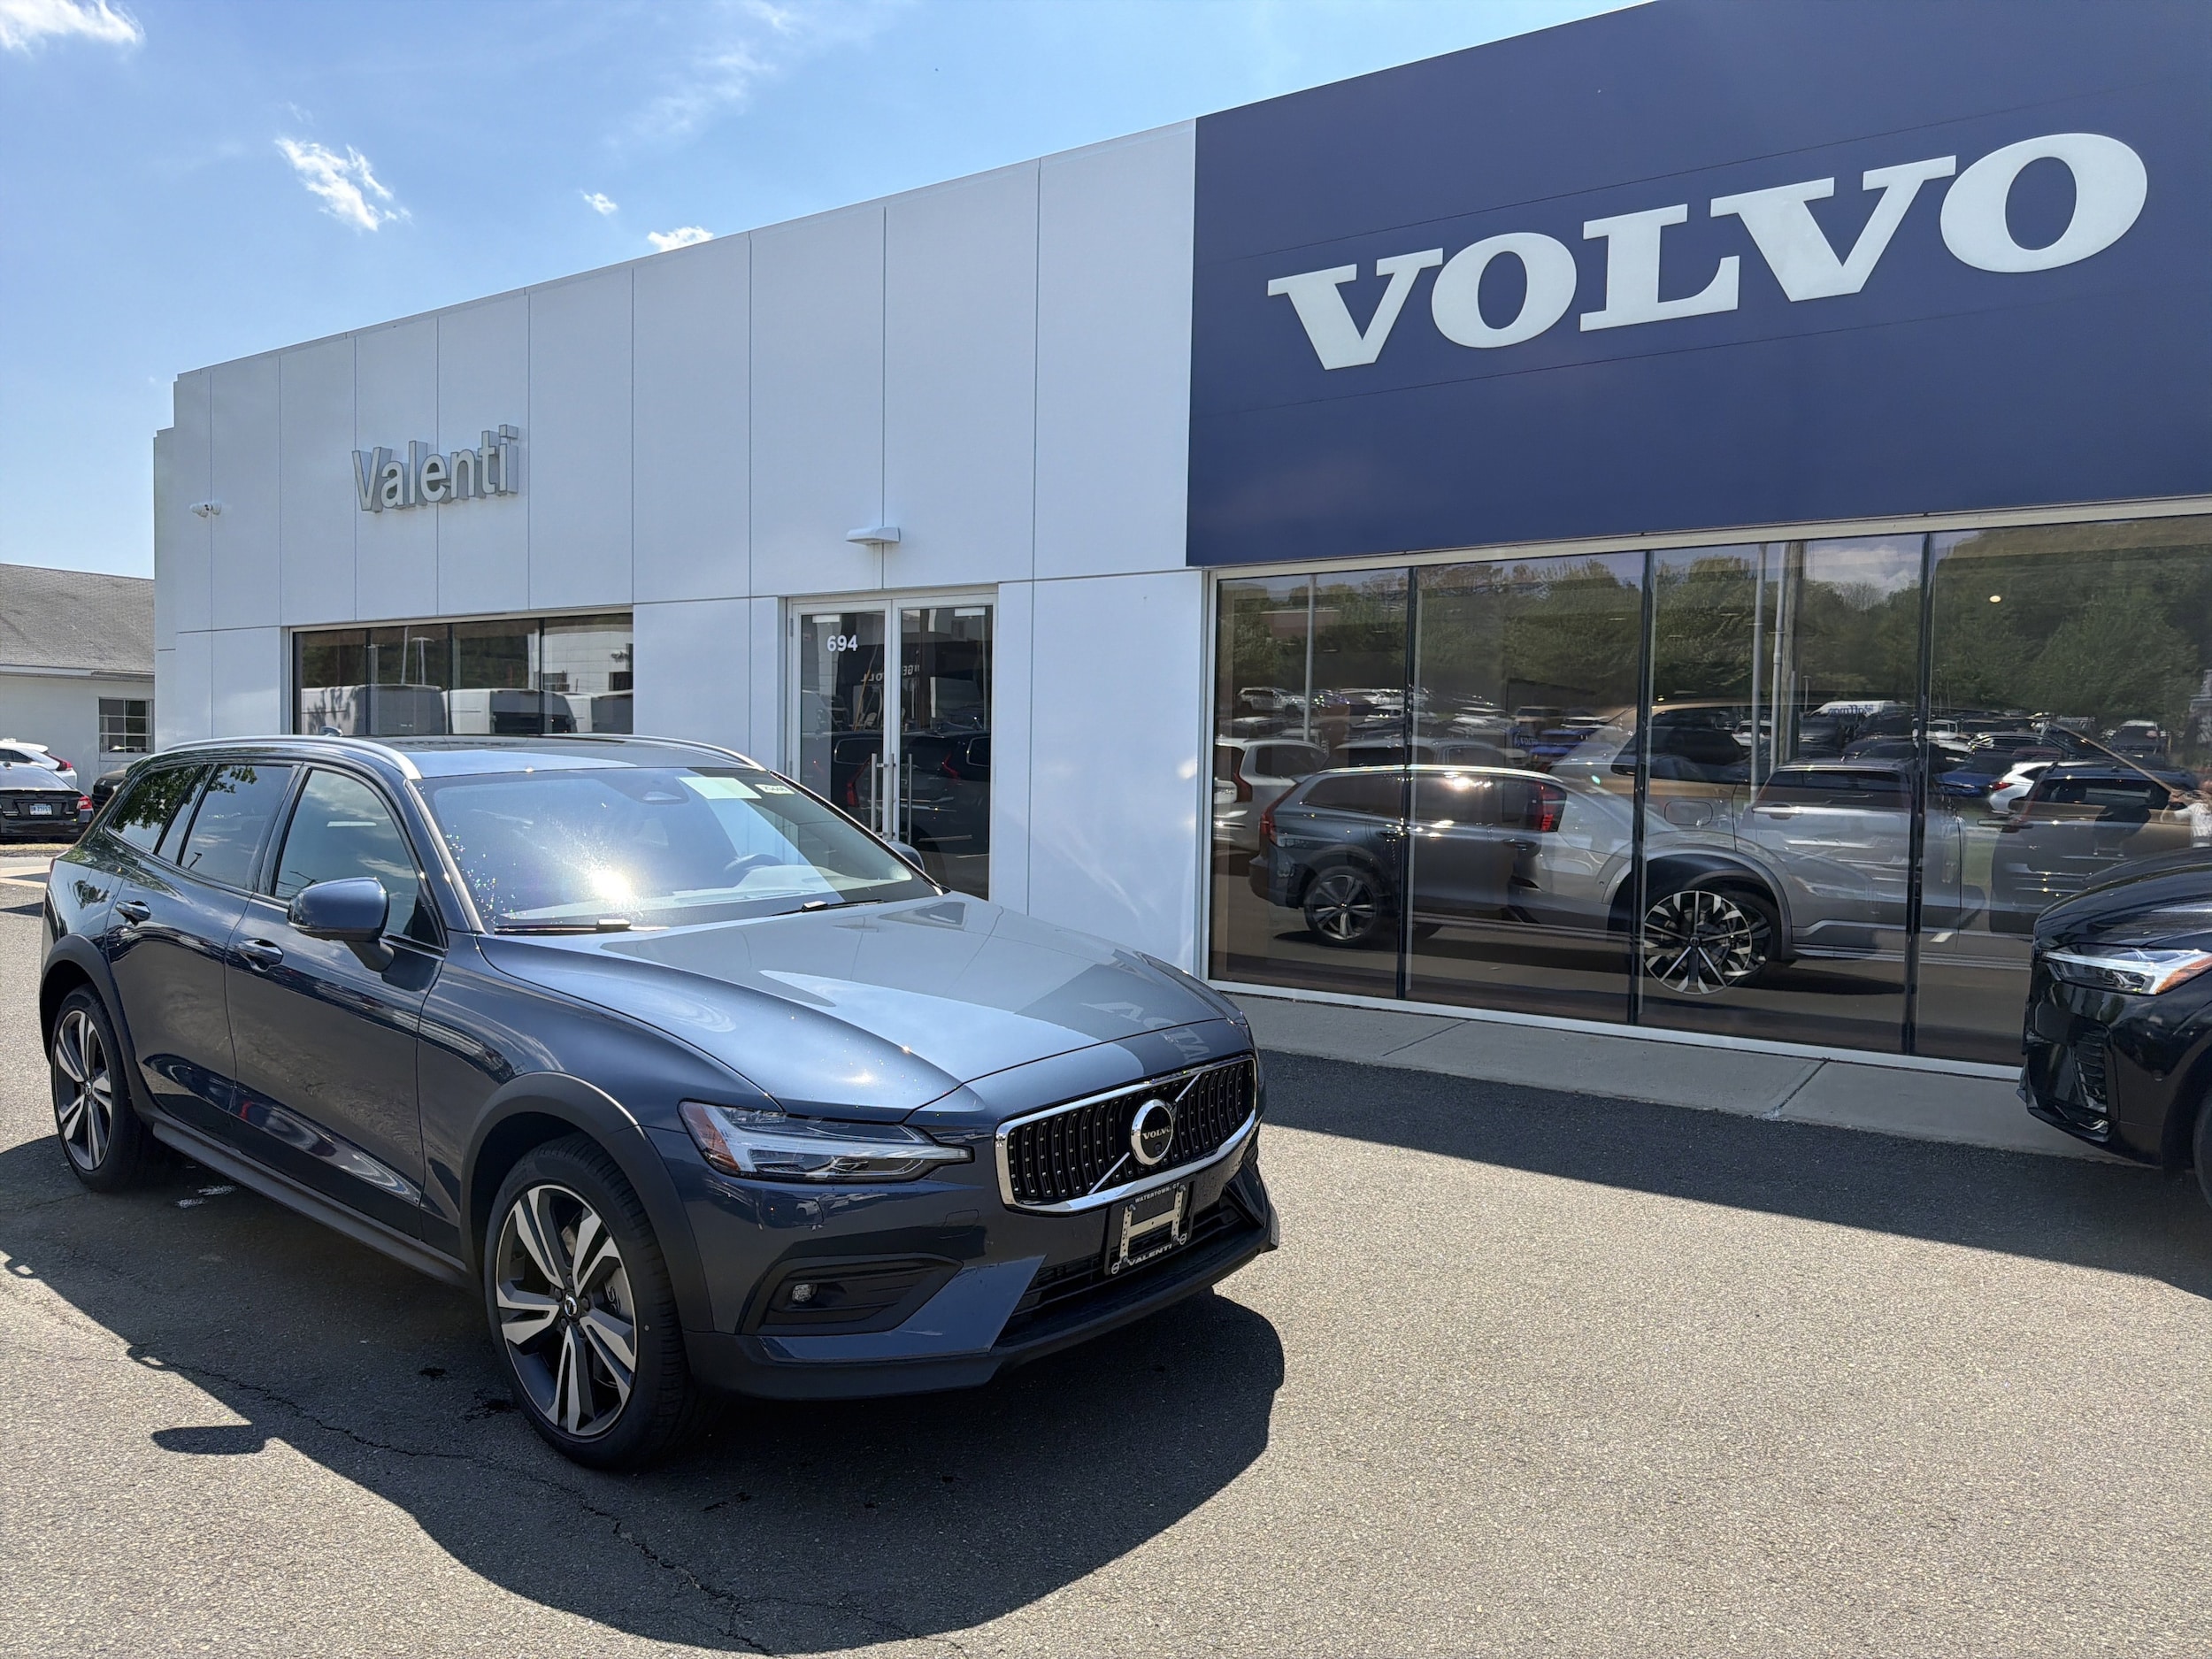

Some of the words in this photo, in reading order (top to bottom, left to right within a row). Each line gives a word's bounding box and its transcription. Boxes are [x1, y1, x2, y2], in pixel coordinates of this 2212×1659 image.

[1267, 132, 2148, 371] VOLVO
[352, 424, 517, 511] Valenti
[826, 634, 858, 652] 694
[1142, 1125, 1171, 1141] VOLVO
[1135, 1187, 1171, 1203] WATERTOWN,
[1129, 1243, 1172, 1266] VALENTI
